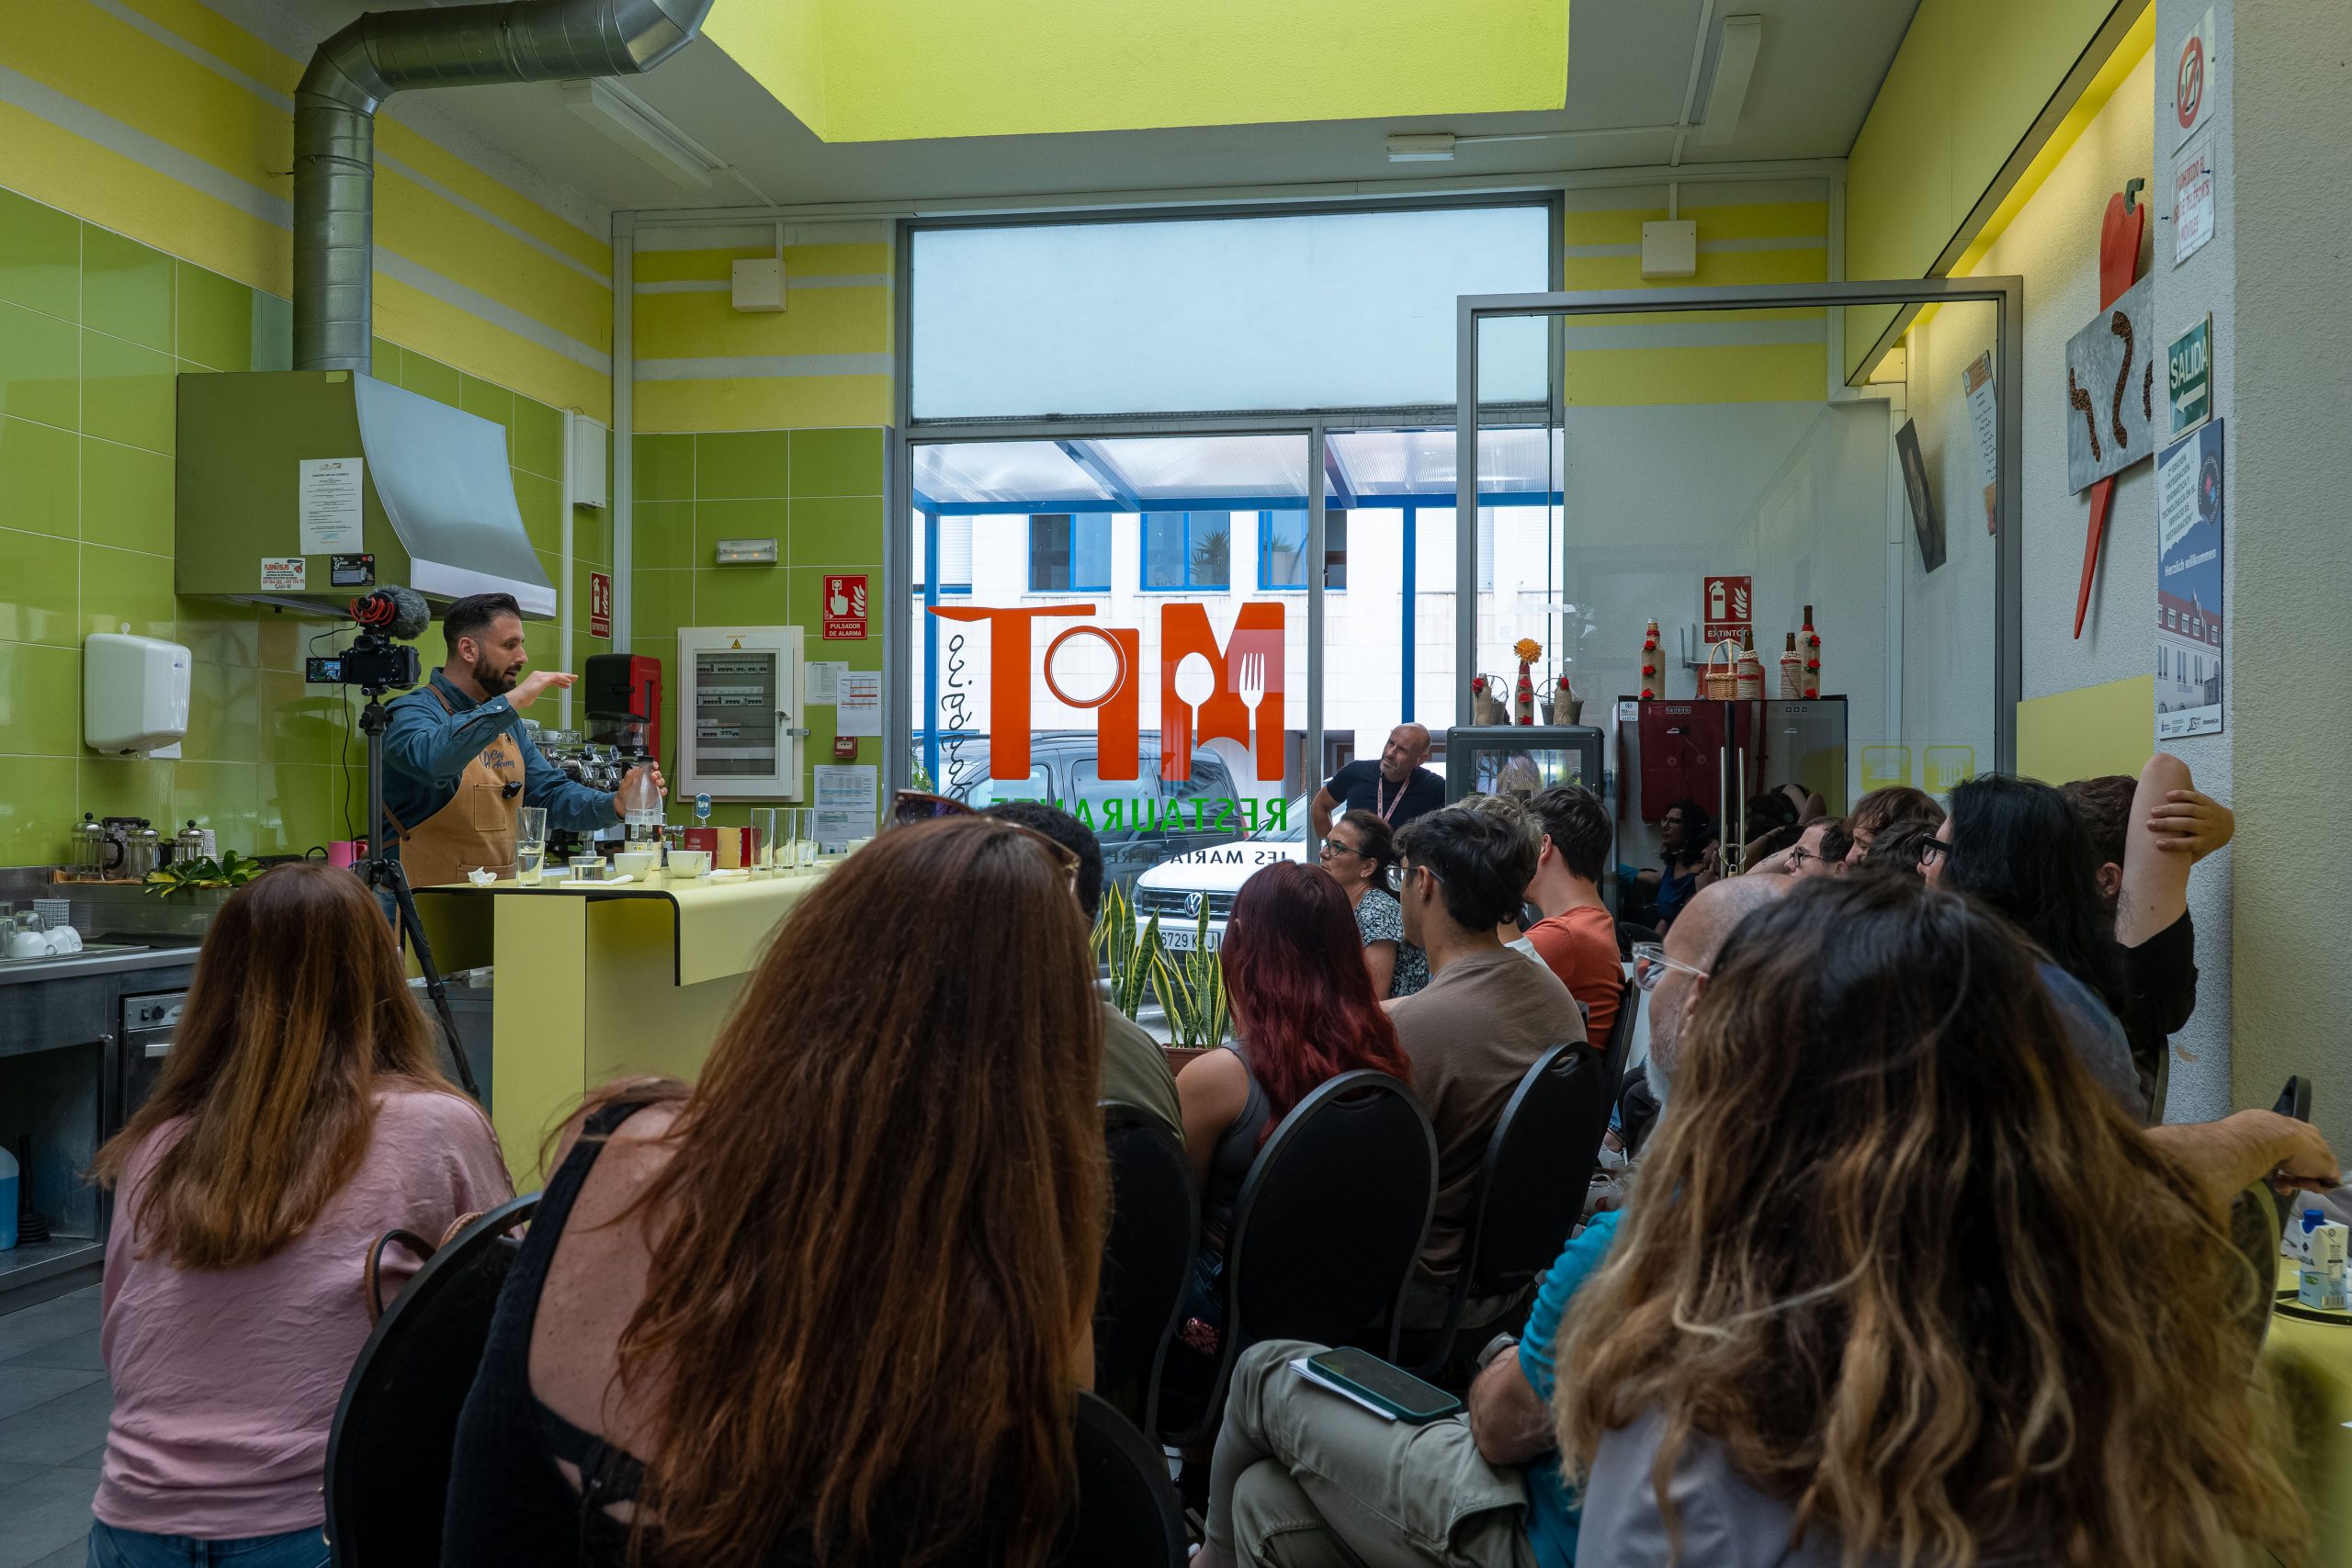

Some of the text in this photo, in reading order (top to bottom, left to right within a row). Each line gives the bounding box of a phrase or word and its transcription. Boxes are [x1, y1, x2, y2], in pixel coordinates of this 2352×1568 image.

[2170, 335, 2209, 389] SALIDA
[2165, 547, 2216, 578] Herzlich willkommen
[1160, 931, 1215, 950] 6729 KJ
